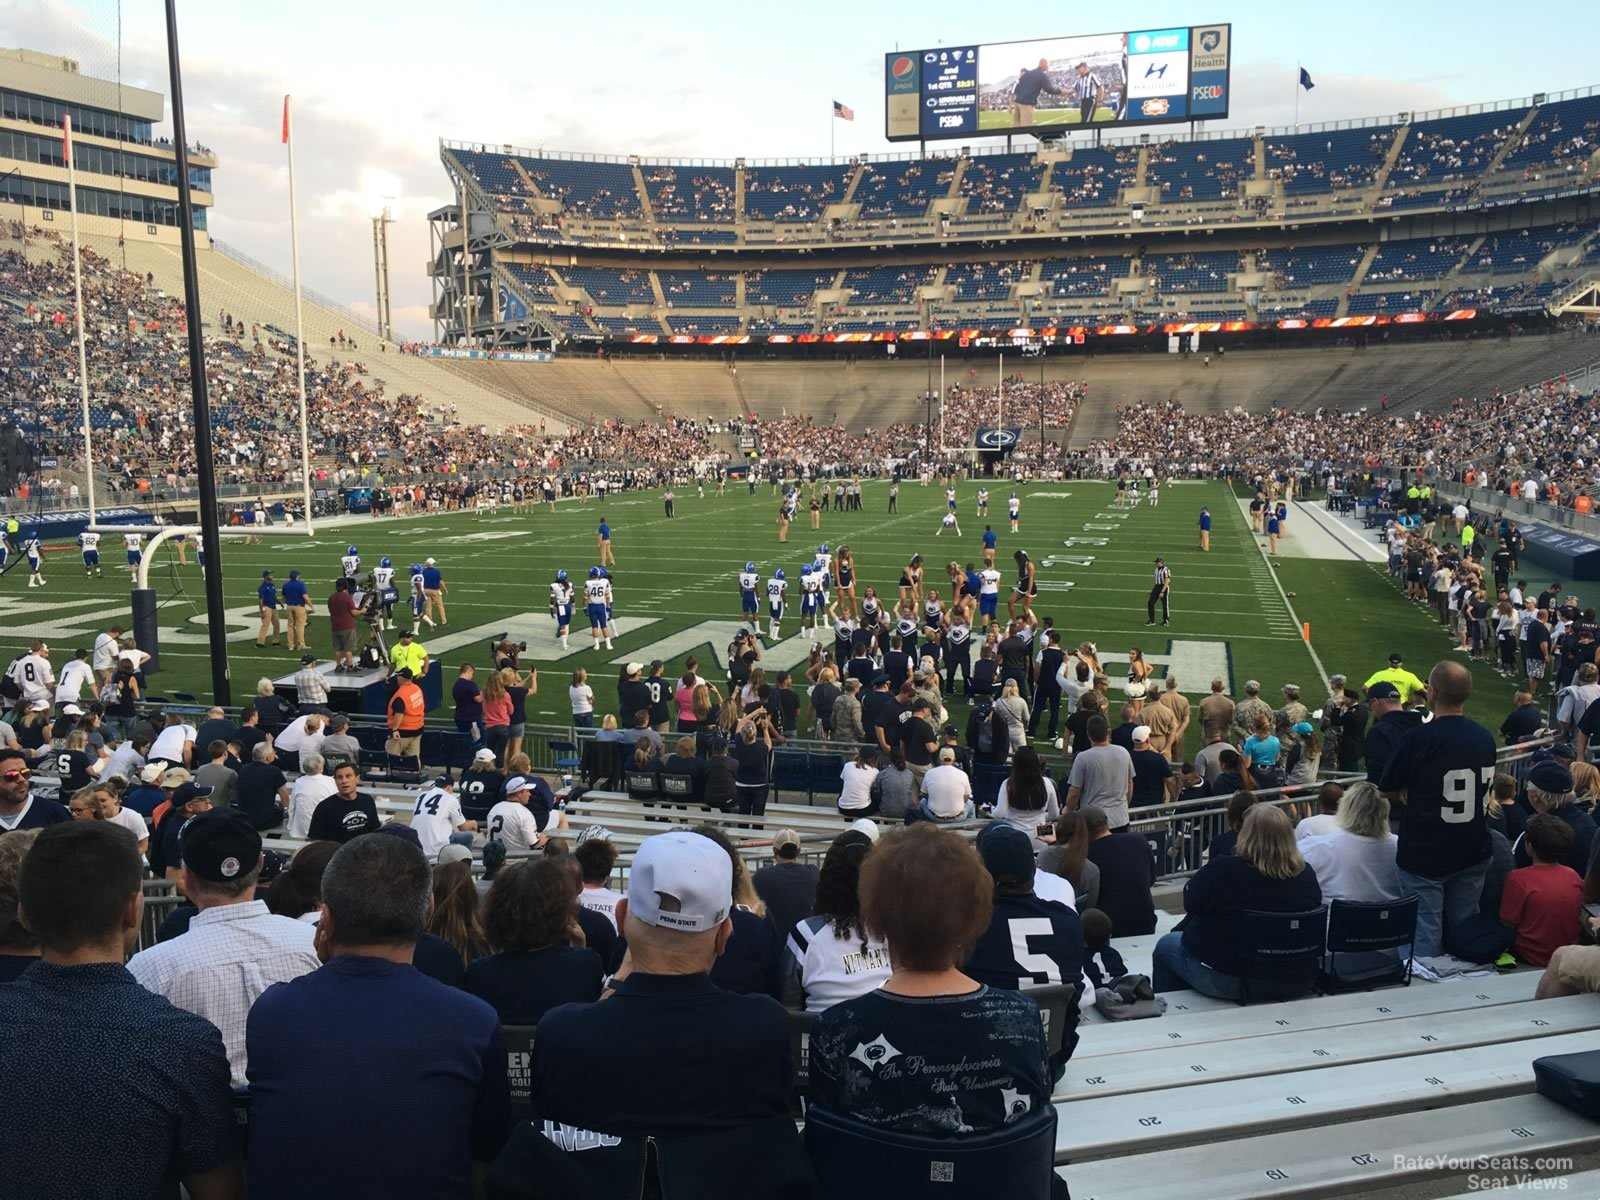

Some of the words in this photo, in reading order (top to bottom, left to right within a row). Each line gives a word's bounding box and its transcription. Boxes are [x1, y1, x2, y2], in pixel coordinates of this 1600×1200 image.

[1194, 58, 1225, 68] Health
[455, 350, 470, 358] ZONE
[524, 353, 539, 361] ZONE
[85, 537, 96, 546] 62
[130, 538, 138, 547] 10
[344, 560, 353, 570] 81
[377, 573, 387, 584] 17
[590, 586, 604, 597] 46
[768, 584, 780, 596] 28
[24, 662, 35, 682] 8
[60, 670, 69, 686] 1
[58, 753, 72, 774] S
[414, 793, 443, 816] 14
[1130, 824, 1156, 832] SECTION
[586, 903, 613, 913] STATE
[659, 915, 677, 925] PENN
[677, 918, 697, 927] STATE
[1007, 917, 1063, 991] 5
[842, 948, 890, 975] NITTANY
[1092, 951, 1114, 985] 1
[1376, 1006, 1392, 1014] 12
[1531, 1018, 1550, 1027] 12
[1421, 1033, 1438, 1042] 14
[905, 1054, 1002, 1077] Pennsylvania
[931, 1077, 959, 1094] State
[960, 1074, 1014, 1090] University
[1085, 1076, 1106, 1085] 20
[1286, 1095, 1307, 1105] 18
[1138, 1116, 1162, 1127] 20
[1511, 1127, 1536, 1138] 18
[1265, 1168, 1290, 1180] 19
